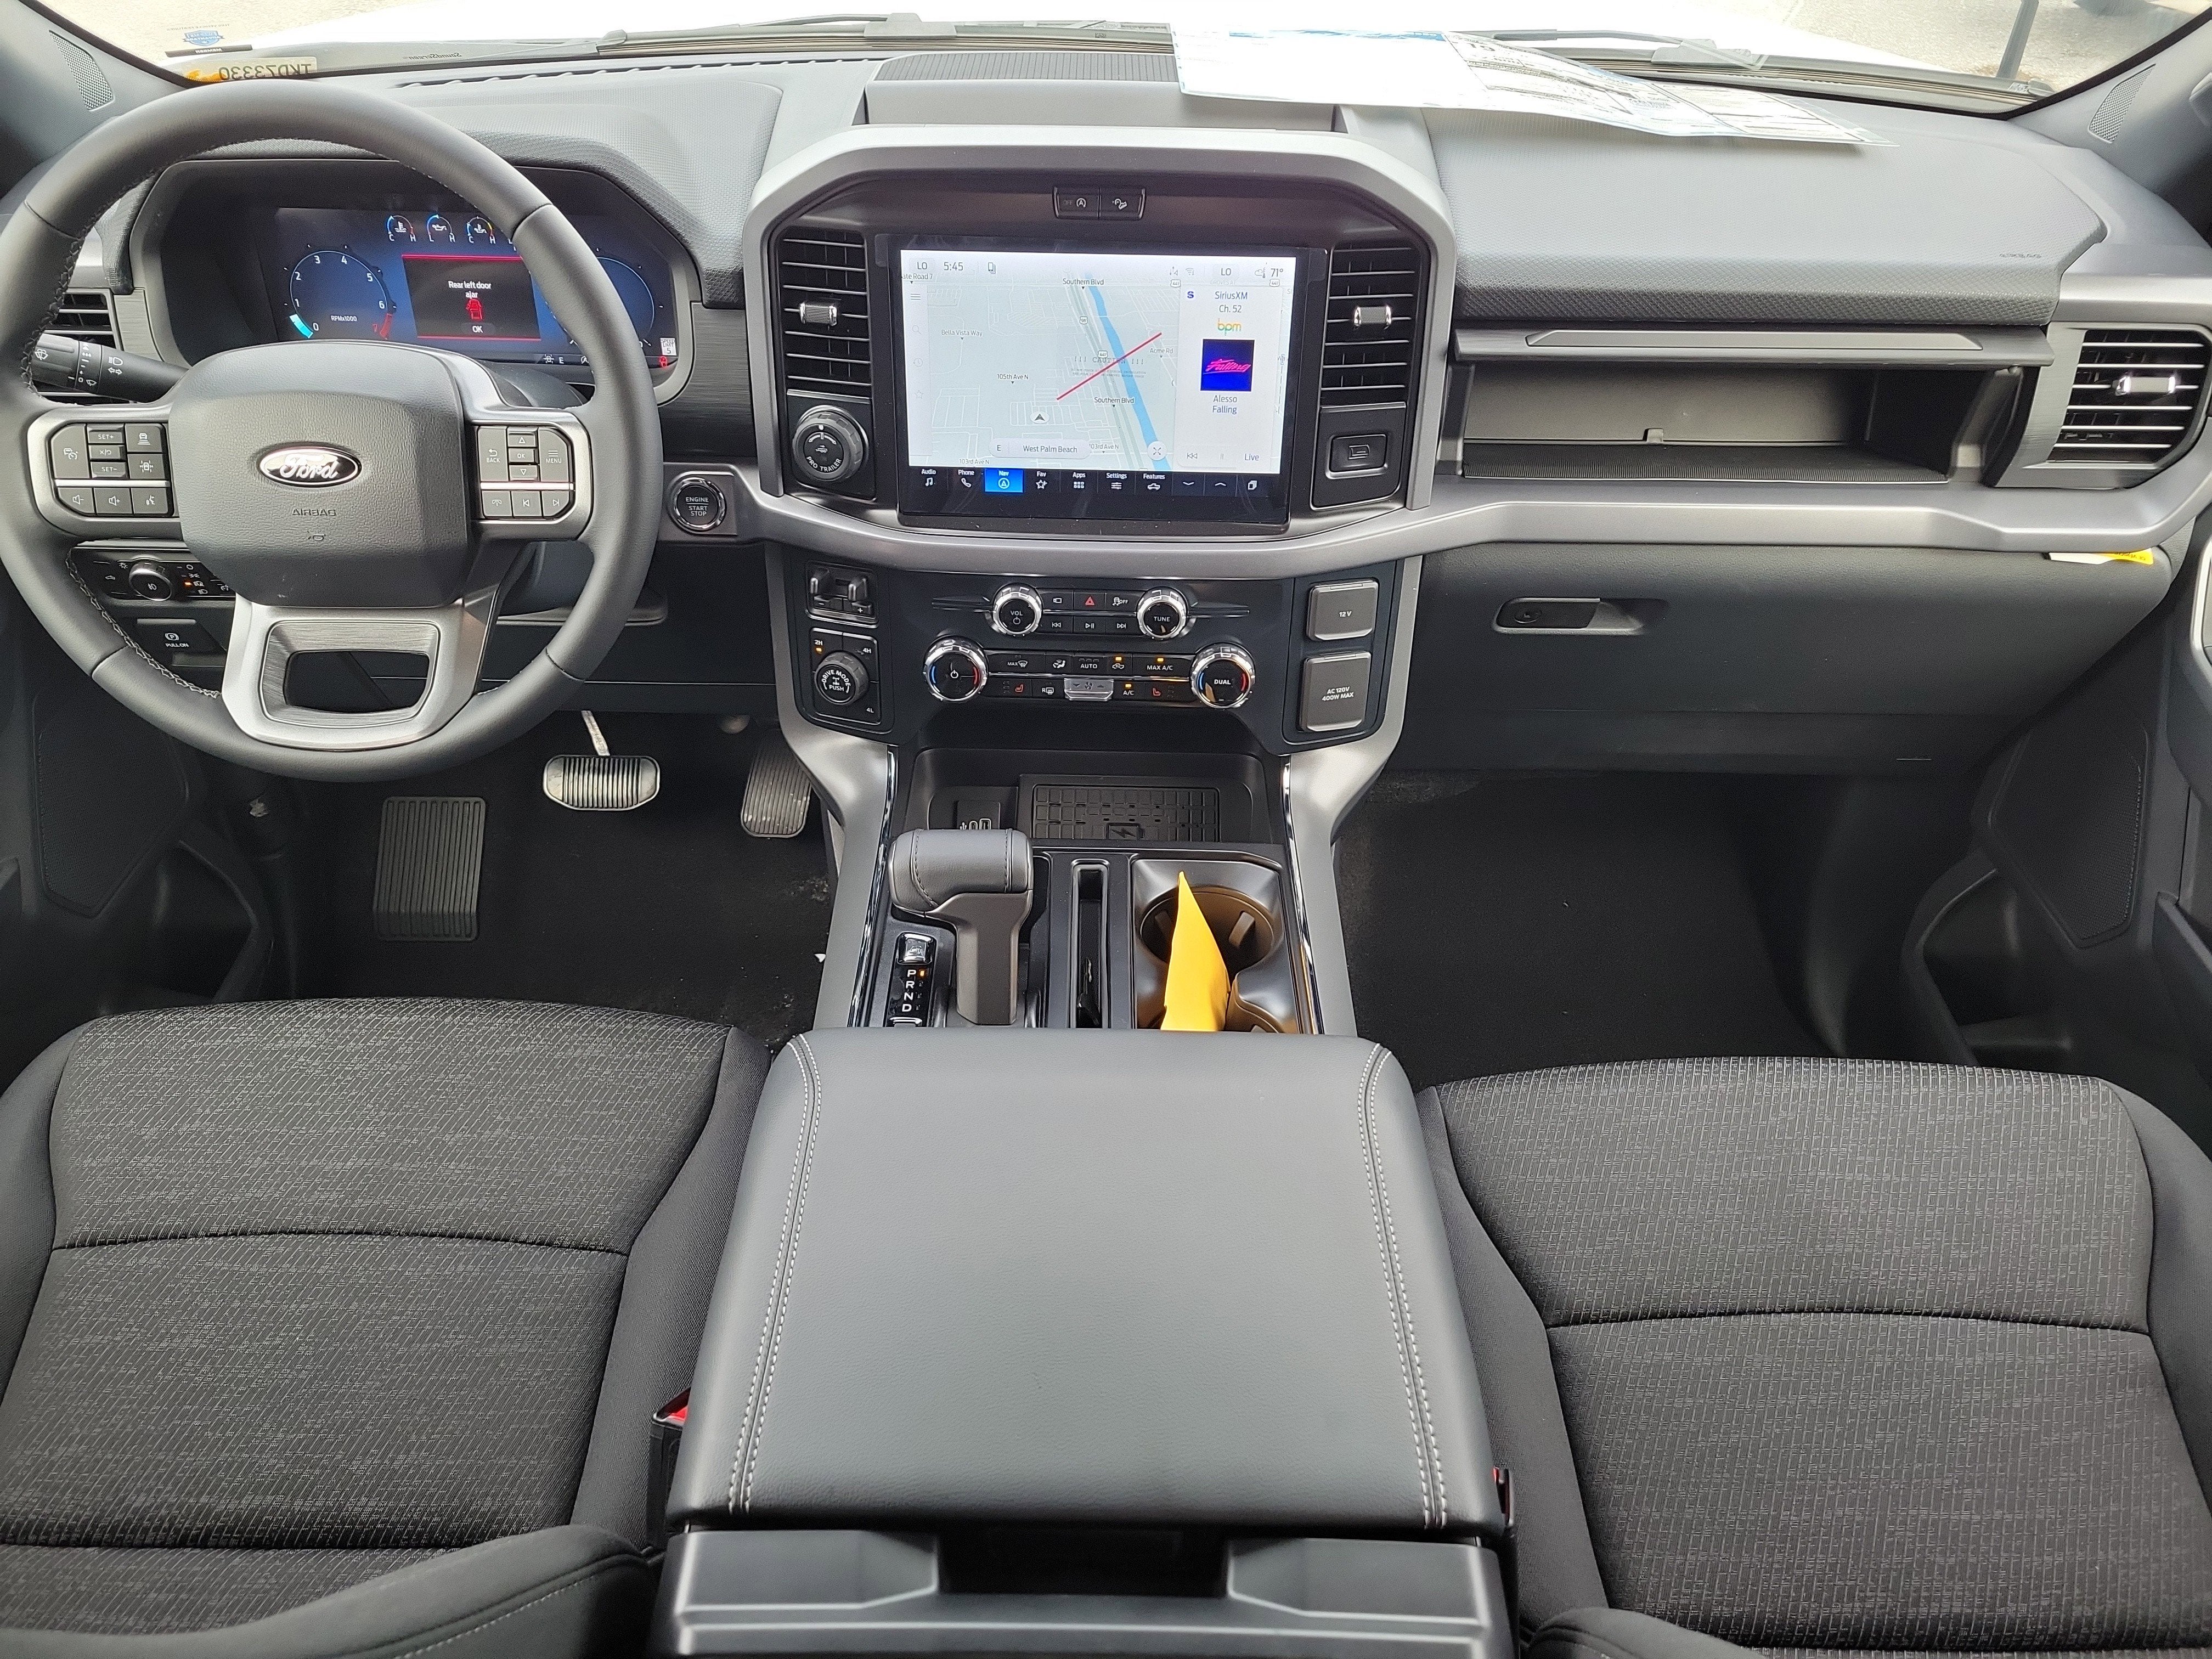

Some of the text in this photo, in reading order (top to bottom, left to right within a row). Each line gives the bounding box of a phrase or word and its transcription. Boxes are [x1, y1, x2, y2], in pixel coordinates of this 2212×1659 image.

[410, 234, 417, 242] H
[489, 236, 496, 244] H
[314, 255, 321, 264] 3
[341, 255, 348, 264] 4
[917, 262, 928, 270] LO
[944, 262, 963, 271] 5:45
[294, 272, 302, 280] 2
[1221, 268, 1232, 276] LO
[1271, 268, 1284, 277] 71°
[366, 273, 373, 282] 5
[448, 280, 464, 289] Rear
[465, 280, 475, 289] left
[465, 291, 478, 300] ajar
[1215, 291, 1248, 300] SiriusXM
[295, 298, 300, 307] 1
[379, 301, 385, 309] 6
[1219, 304, 1242, 313] Ch. 52
[313, 323, 319, 331] 0
[472, 325, 483, 334] OK
[1217, 318, 1242, 336] bpm
[1213, 394, 1237, 403] Alesso
[1212, 405, 1237, 415] Falling
[279, 453, 340, 479] Ford
[806, 455, 842, 472] PRO TRAILER
[292, 508, 336, 517] AIRBAG
[821, 669, 851, 686] DRIVE MODE
[907, 969, 917, 978] P
[905, 980, 915, 989] R
[904, 992, 913, 1001] N
[901, 1003, 912, 1012] D
